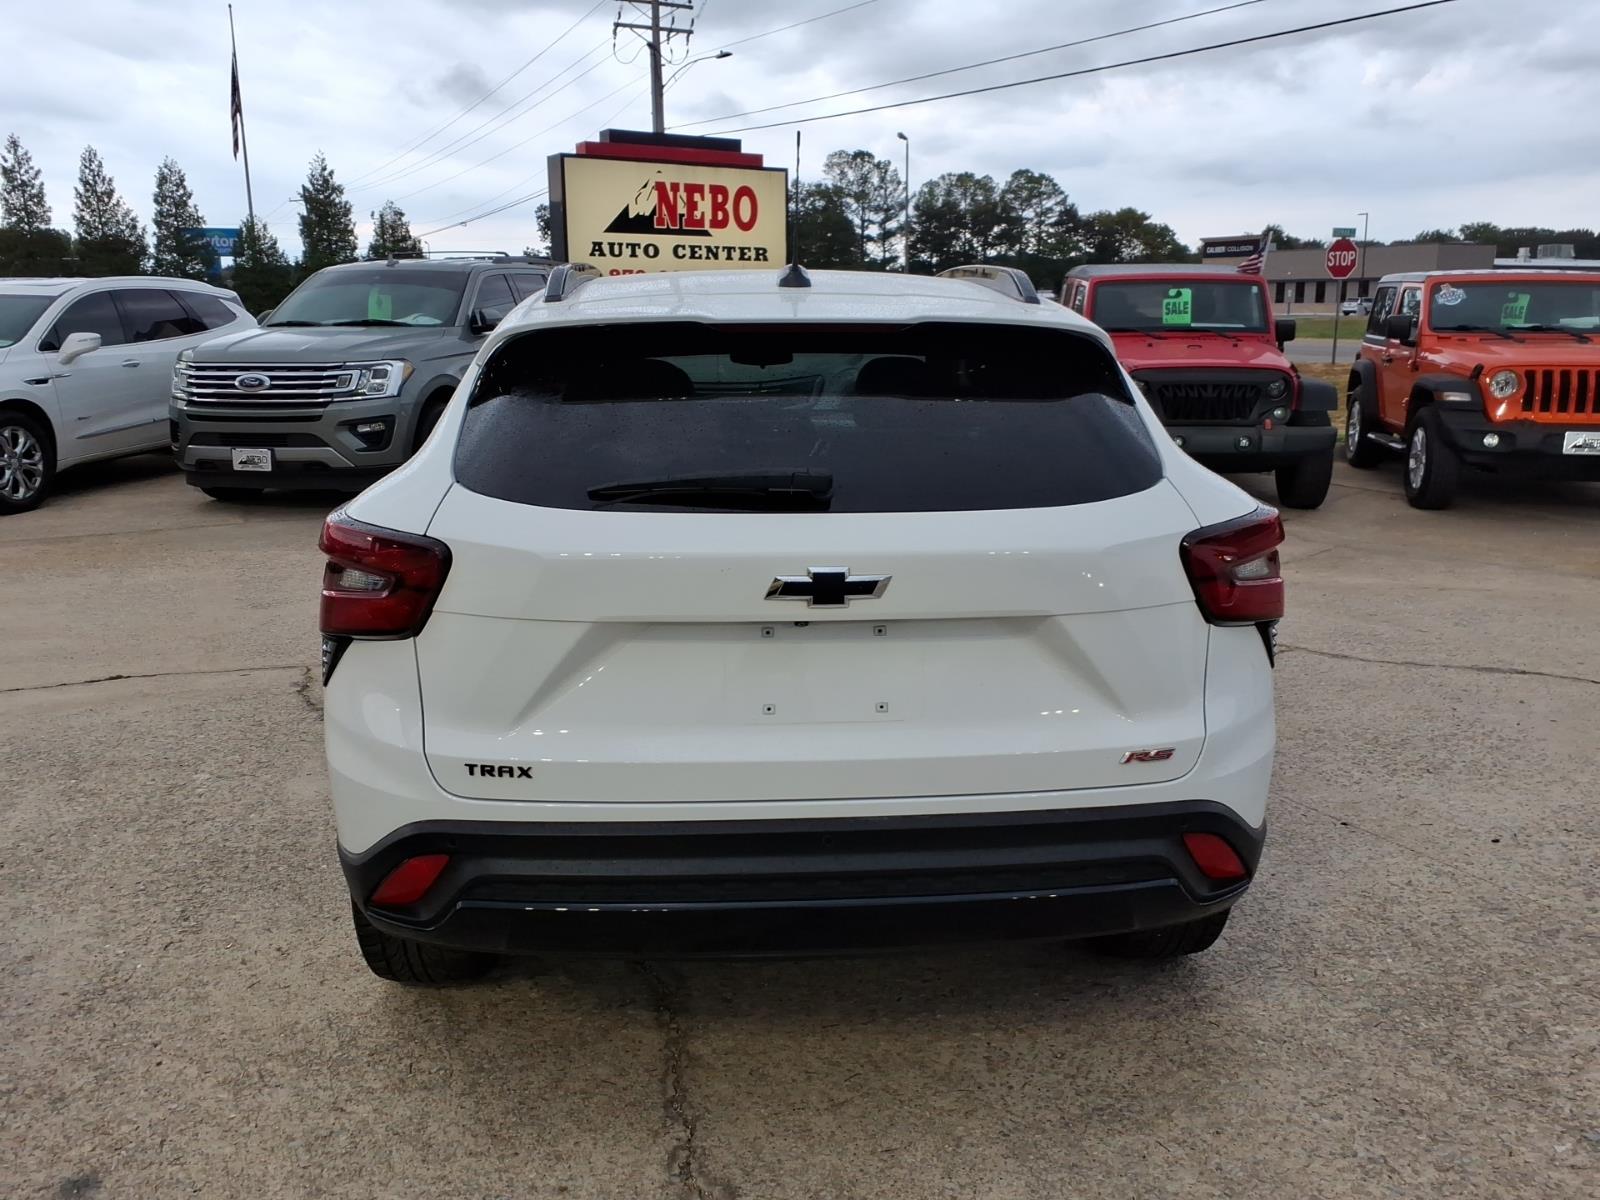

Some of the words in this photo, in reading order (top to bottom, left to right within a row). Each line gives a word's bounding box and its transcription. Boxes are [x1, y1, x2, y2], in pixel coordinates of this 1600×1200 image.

[654, 181, 758, 232] NEBO
[589, 241, 660, 259] AUTO
[673, 244, 769, 262] CENTER
[1327, 250, 1356, 267] STOP
[1164, 301, 1189, 316] SALE
[1119, 747, 1176, 765] RS
[464, 763, 533, 779] TRAX
